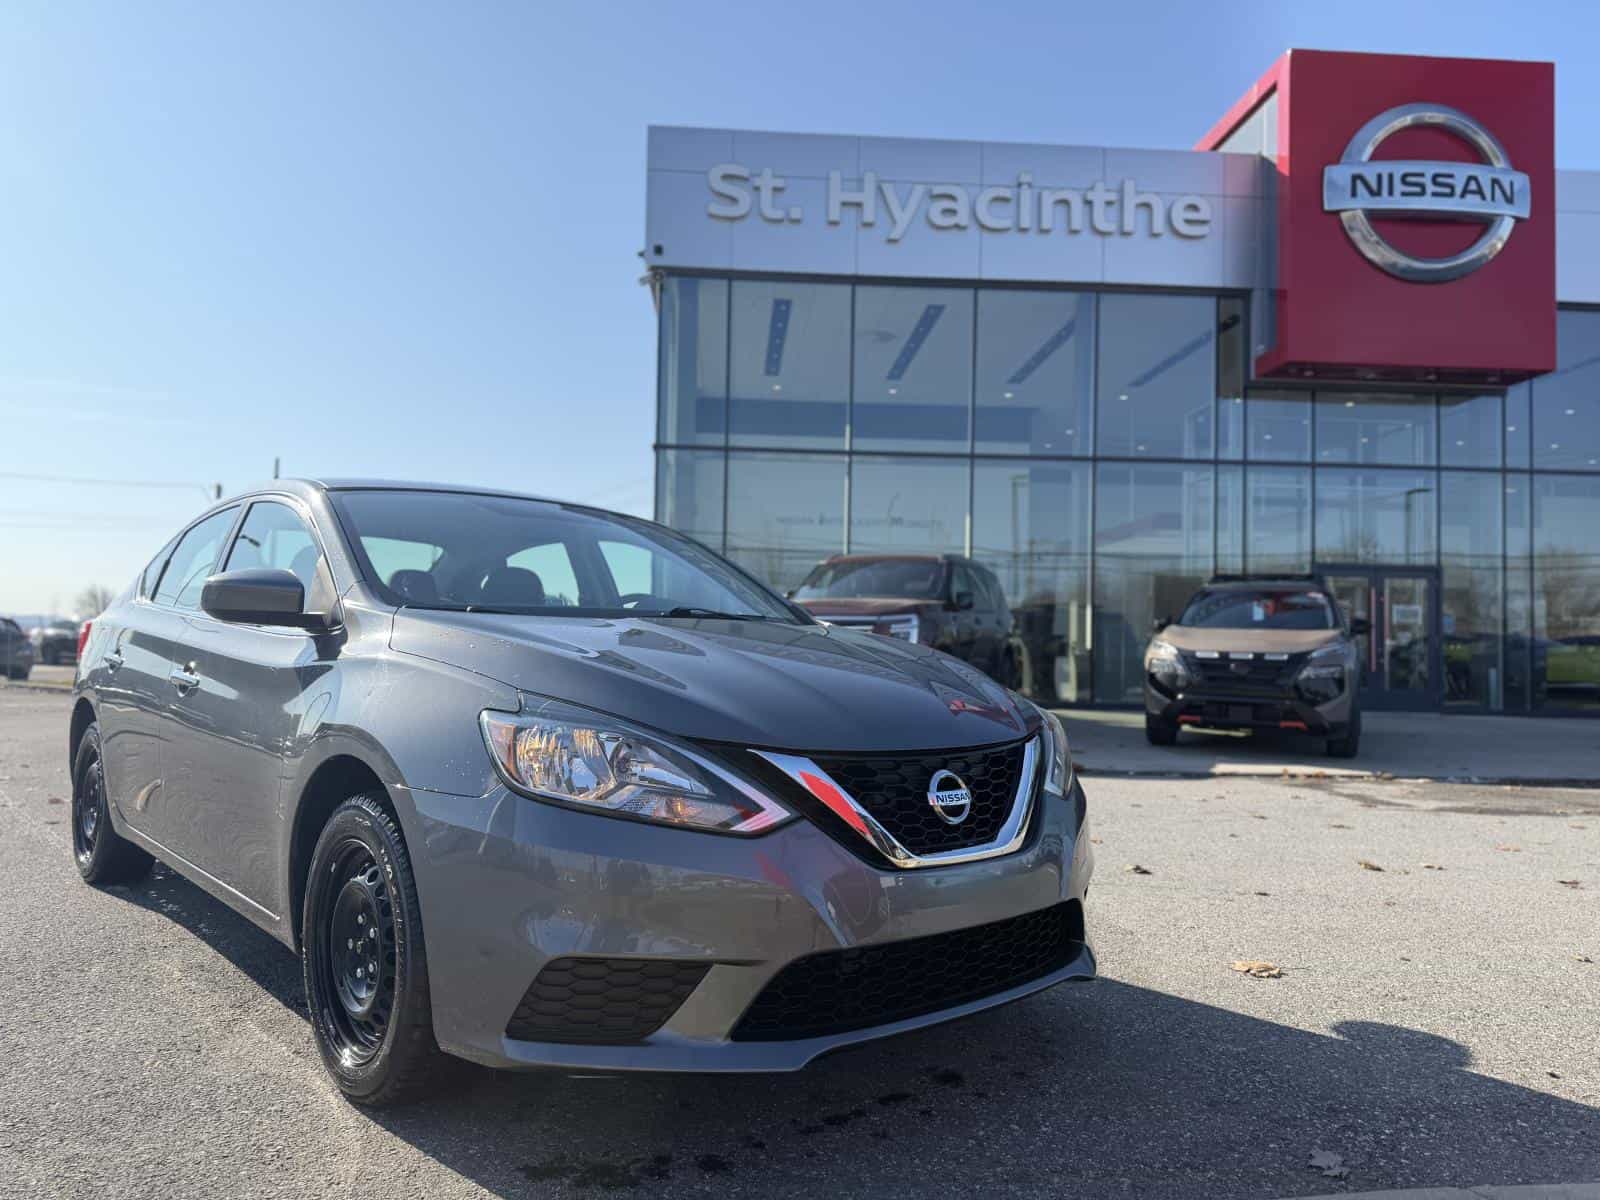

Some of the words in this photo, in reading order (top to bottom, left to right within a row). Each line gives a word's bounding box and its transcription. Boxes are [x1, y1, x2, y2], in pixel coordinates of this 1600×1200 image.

[706, 164, 803, 223] St.
[826, 171, 1213, 242] Hyacinthe
[1350, 171, 1515, 206] NISSAN
[936, 793, 969, 803] NISSAN
